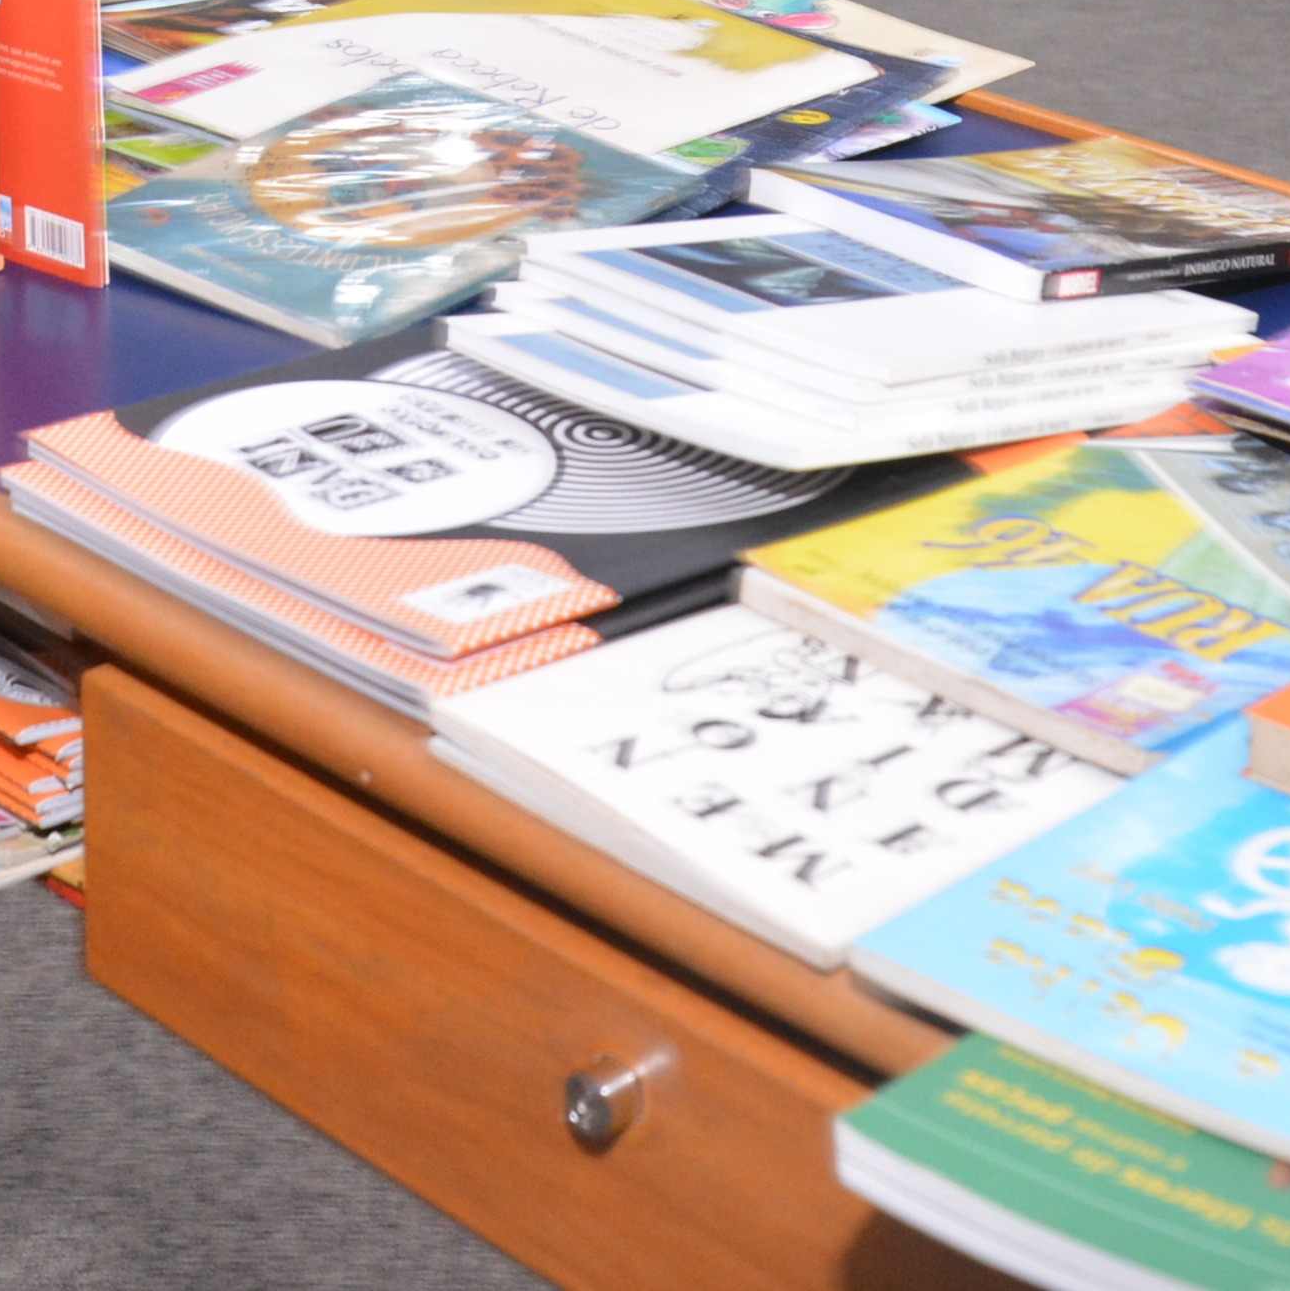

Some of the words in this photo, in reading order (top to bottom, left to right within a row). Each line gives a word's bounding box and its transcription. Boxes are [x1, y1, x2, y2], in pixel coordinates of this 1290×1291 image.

[429, 48, 568, 113] Rebeca
[569, 104, 622, 133] de
[1184, 259, 1229, 278] INIMIGO
[1231, 253, 1276, 272] NATURAL
